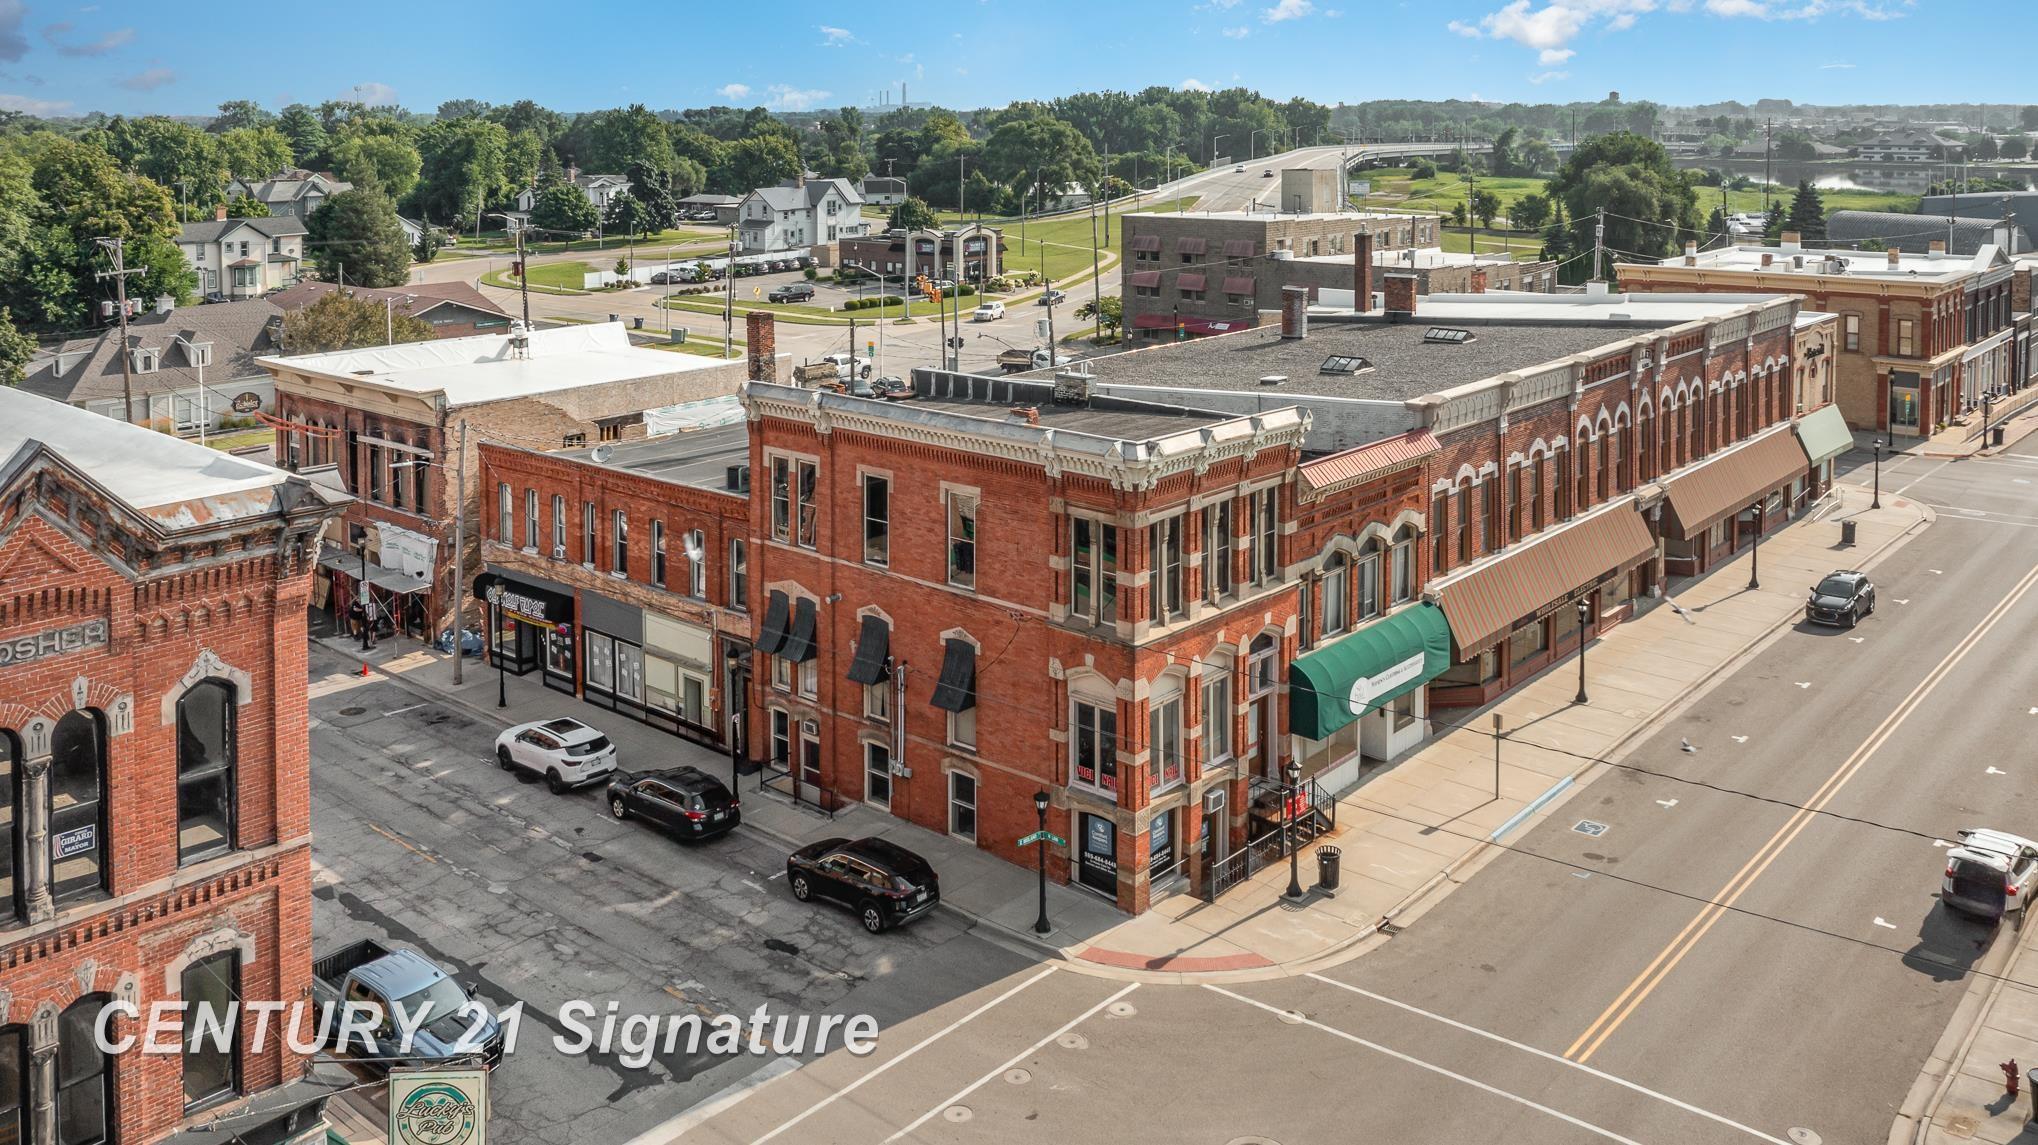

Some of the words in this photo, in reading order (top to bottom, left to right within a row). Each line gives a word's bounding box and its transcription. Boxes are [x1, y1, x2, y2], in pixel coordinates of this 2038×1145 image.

[1536, 594, 1569, 617] WHOLESALE
[61, 831, 93, 846] GIRARD
[396, 1101, 475, 1120] Lucky's
[416, 1120, 456, 1136] Pub
